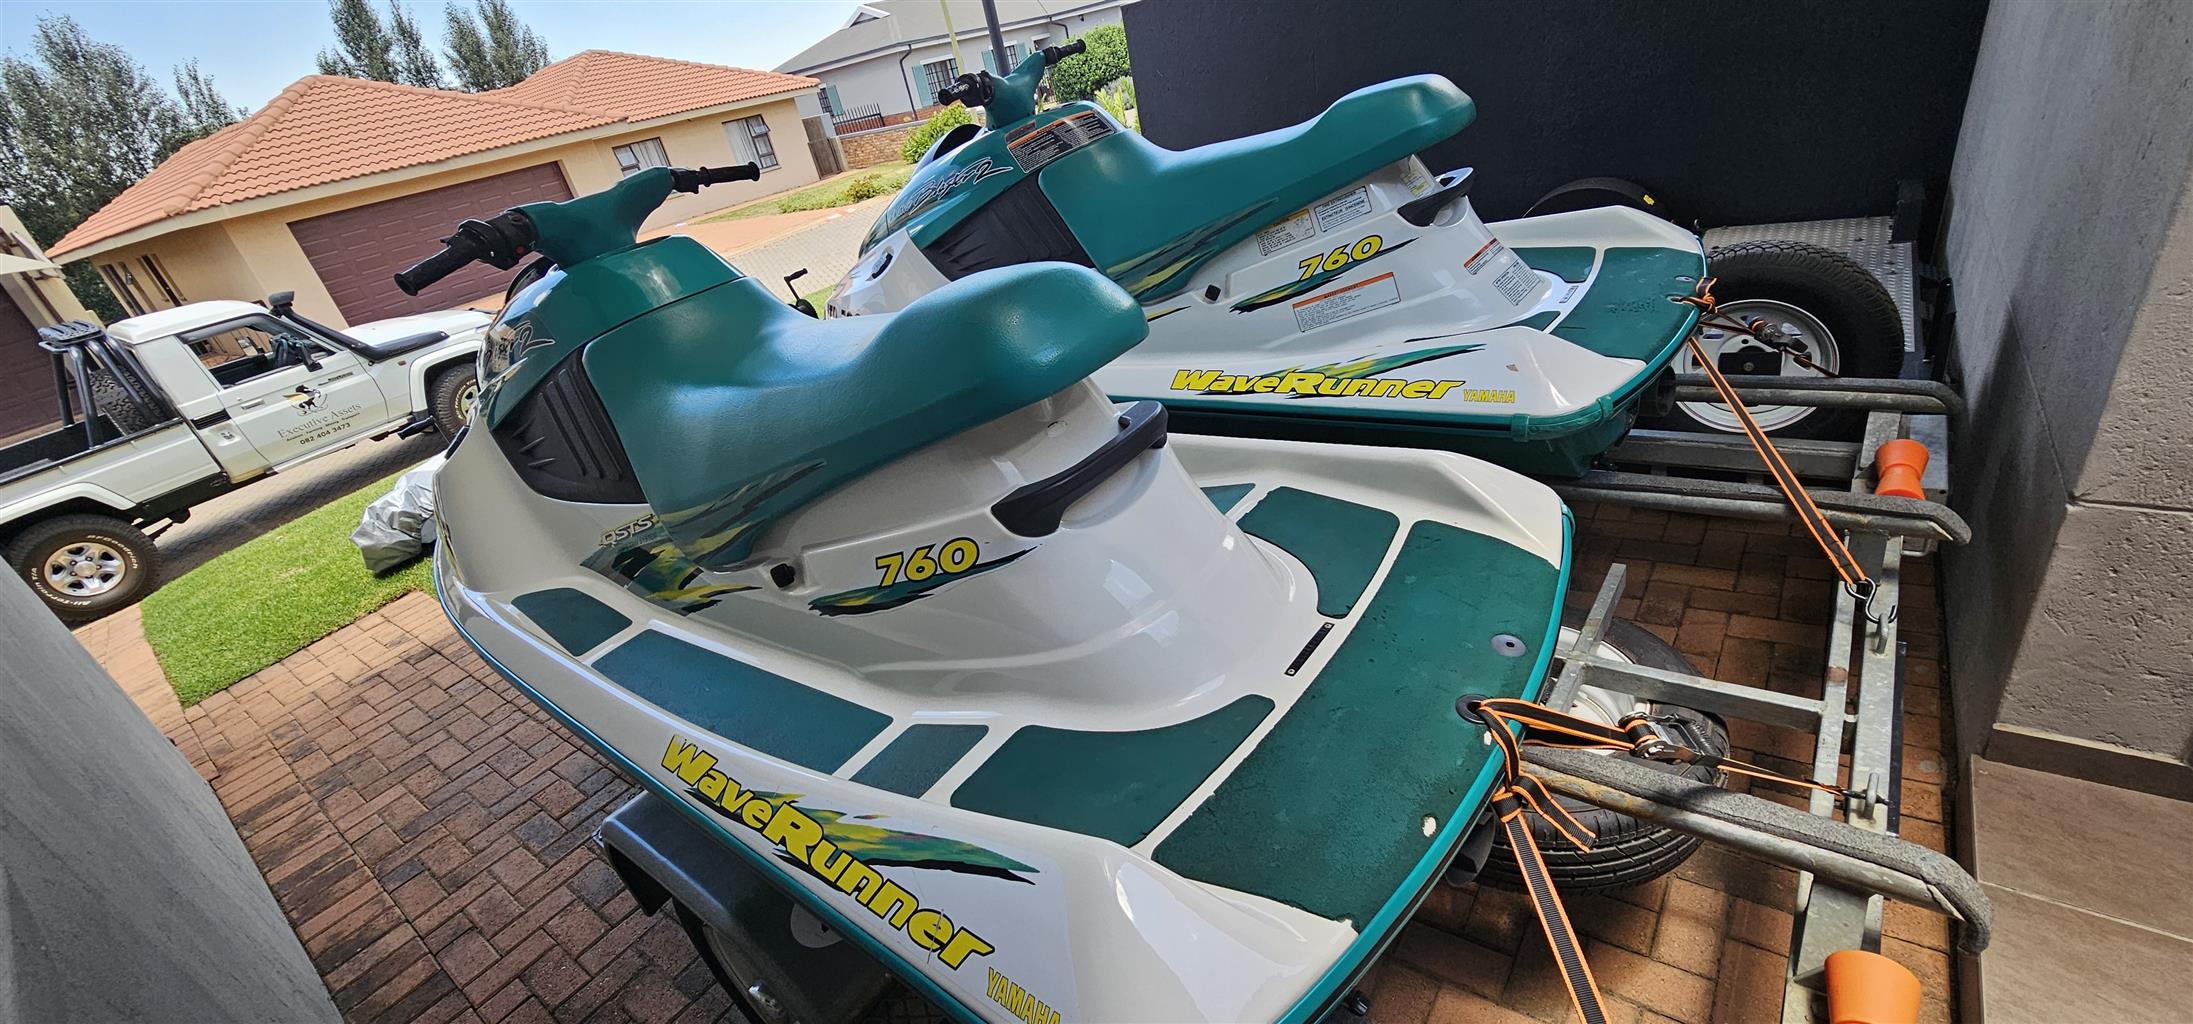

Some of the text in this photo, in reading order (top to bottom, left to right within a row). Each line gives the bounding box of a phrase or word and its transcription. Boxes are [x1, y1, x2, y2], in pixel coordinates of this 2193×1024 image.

[1298, 234, 1383, 282] 760
[1170, 369, 1466, 400] WaveRunner
[1463, 389, 1516, 403] YAMAHA
[276, 415, 328, 438] Executive
[331, 404, 362, 420] Assets
[300, 435, 315, 445] 082
[316, 429, 331, 439] 404
[332, 422, 351, 433] 3473
[875, 537, 980, 587] 760
[661, 734, 995, 970] WaveRunner
